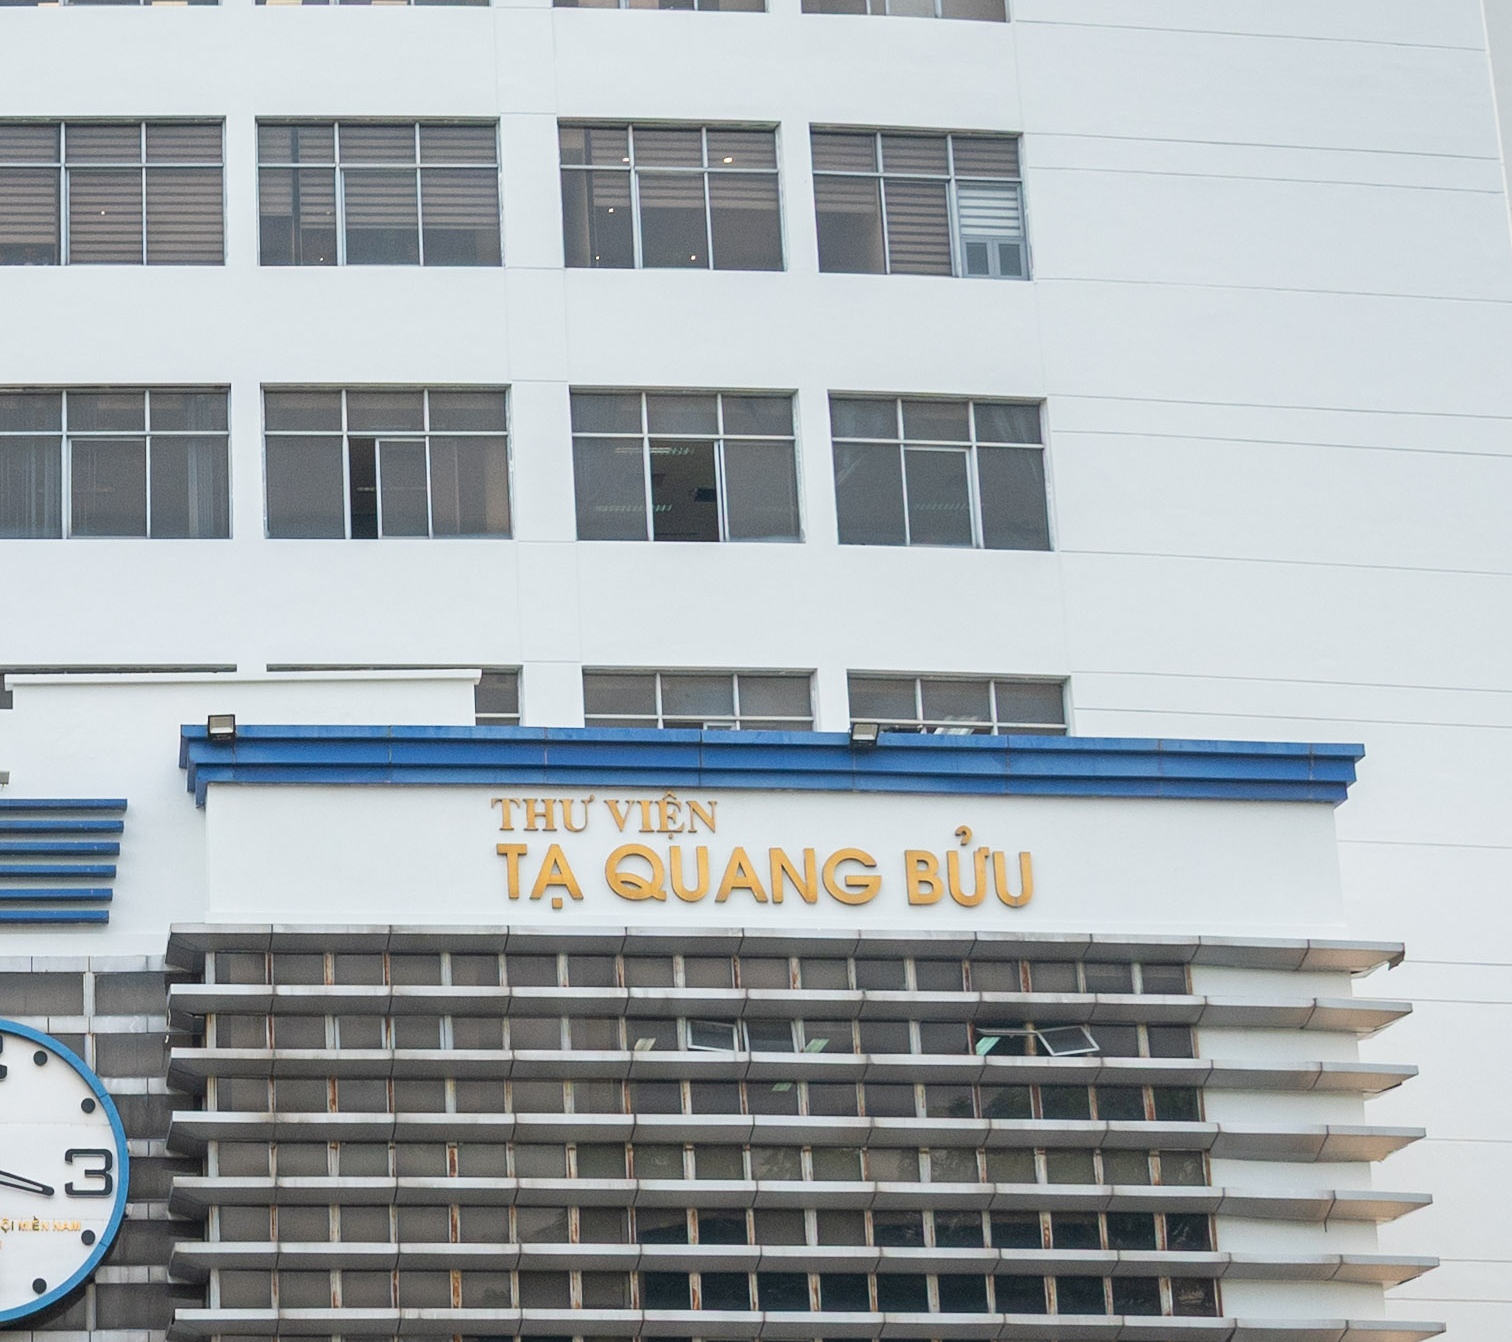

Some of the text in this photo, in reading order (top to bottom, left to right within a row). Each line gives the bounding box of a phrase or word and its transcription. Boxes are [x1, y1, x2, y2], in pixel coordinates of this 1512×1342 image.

[491, 791, 718, 840] THƯ VIỆN
[495, 824, 1034, 910] TẠ QUANG BỬU
[64, 1148, 114, 1197] 3
